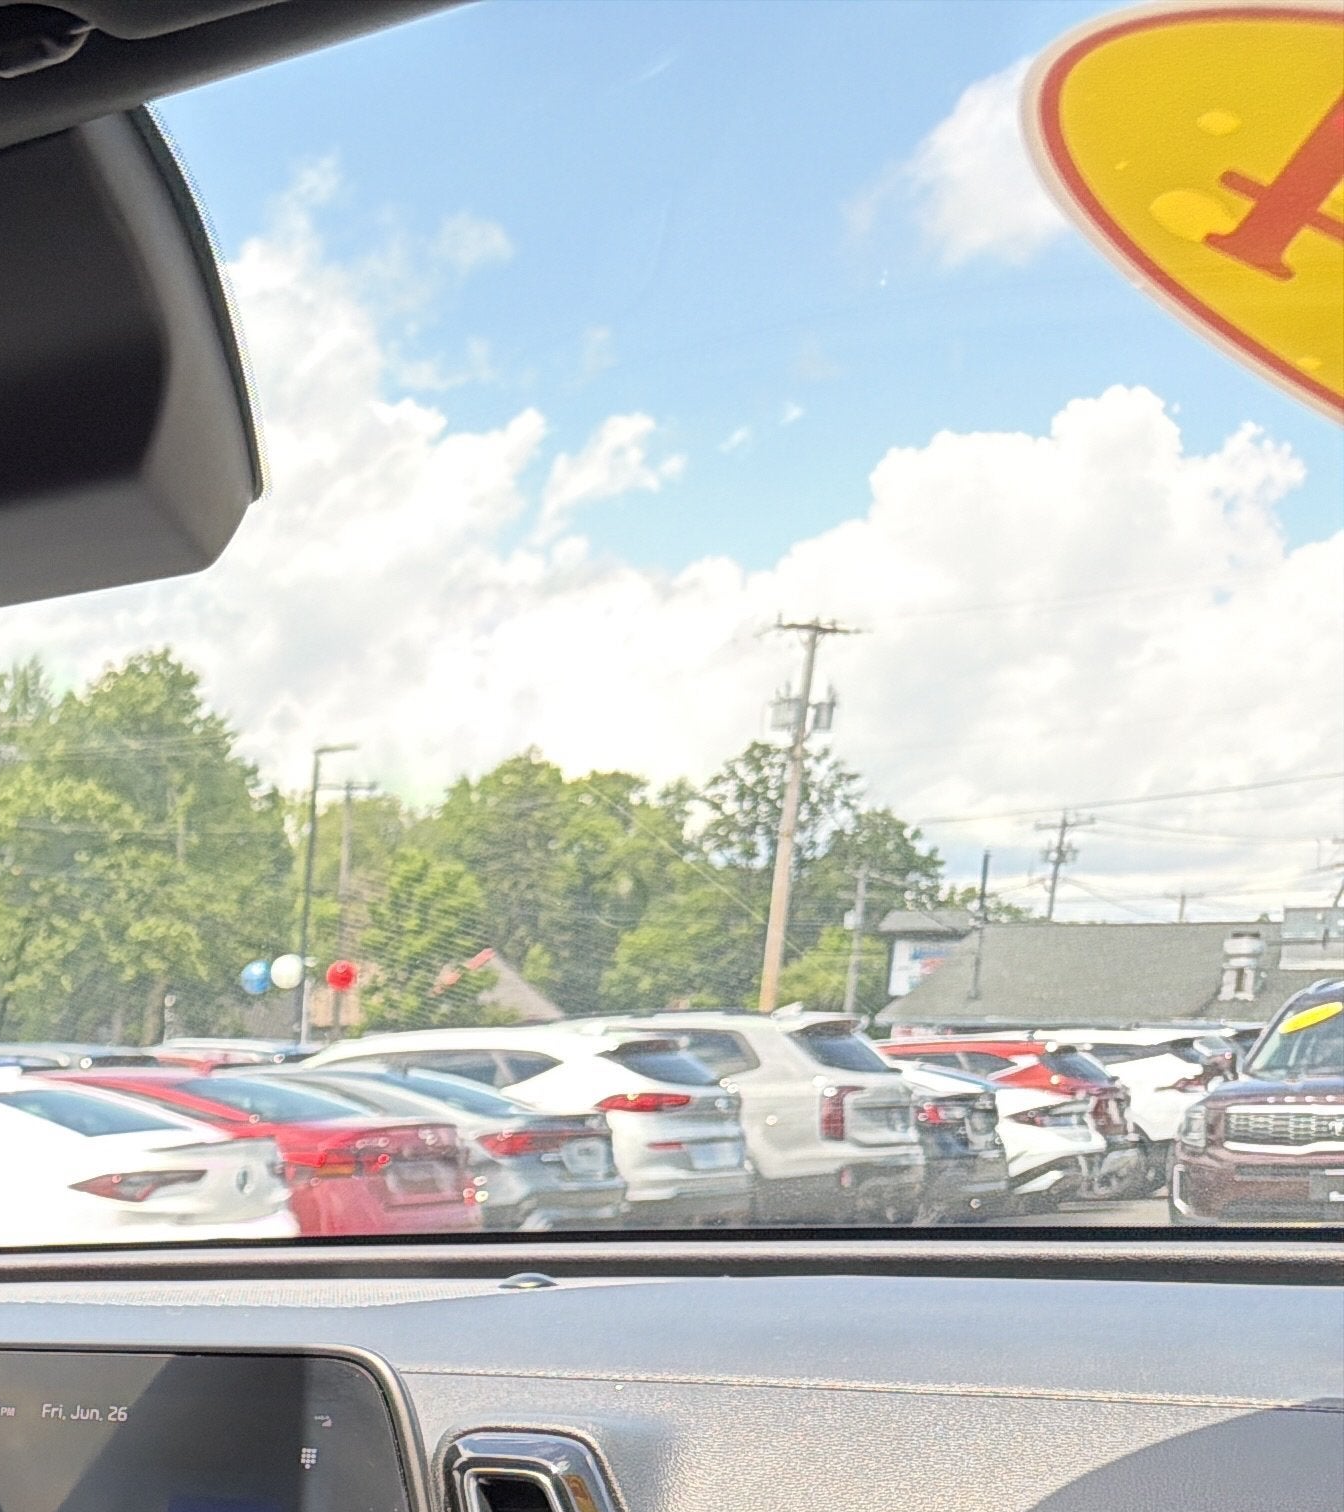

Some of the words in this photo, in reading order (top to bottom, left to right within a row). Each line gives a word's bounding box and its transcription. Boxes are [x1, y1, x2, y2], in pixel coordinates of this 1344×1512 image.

[0, 1407, 15, 1417] PM
[70, 1405, 103, 1421] Jun.
[107, 1406, 128, 1422] 26
